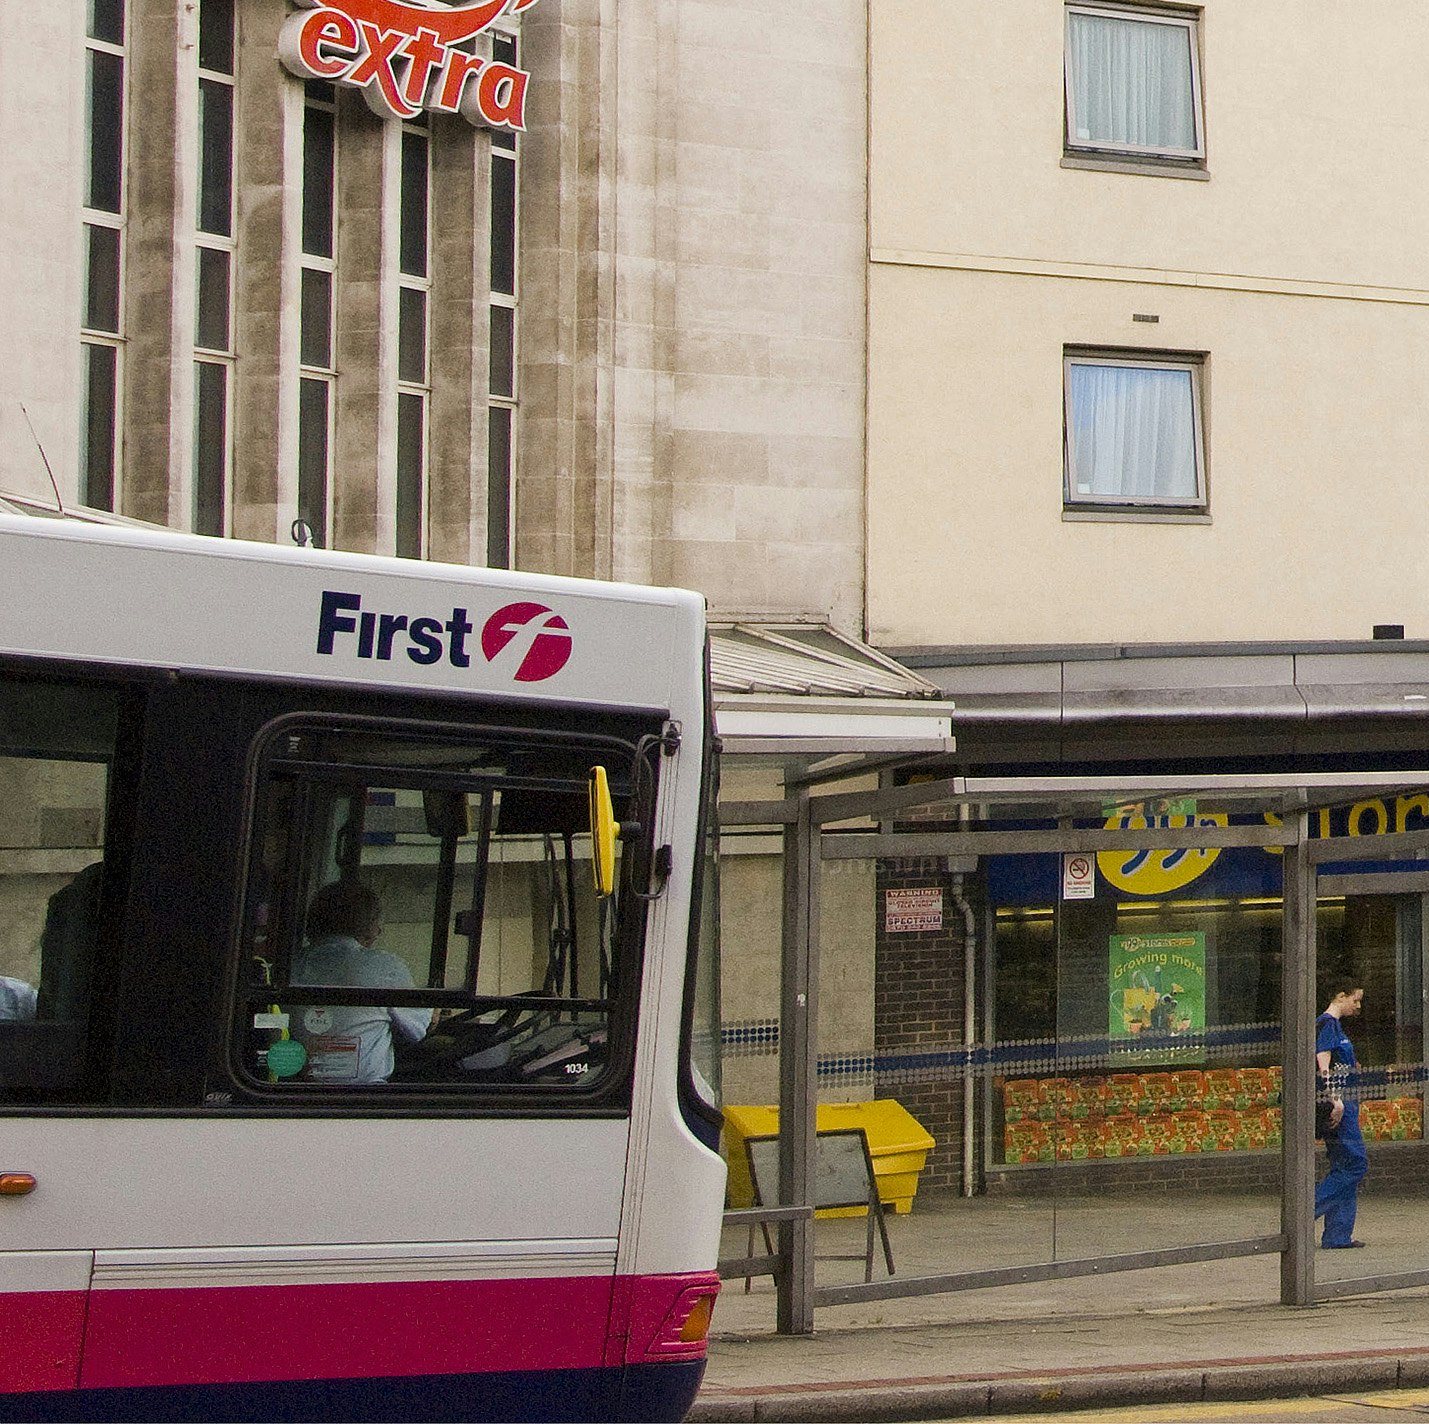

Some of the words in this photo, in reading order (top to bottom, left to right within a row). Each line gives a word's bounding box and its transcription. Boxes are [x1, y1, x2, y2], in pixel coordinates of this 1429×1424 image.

[298, 7, 532, 132] extra
[316, 590, 473, 668] First
[1113, 952, 1167, 978] Growing
[564, 1063, 588, 1074] 1034
